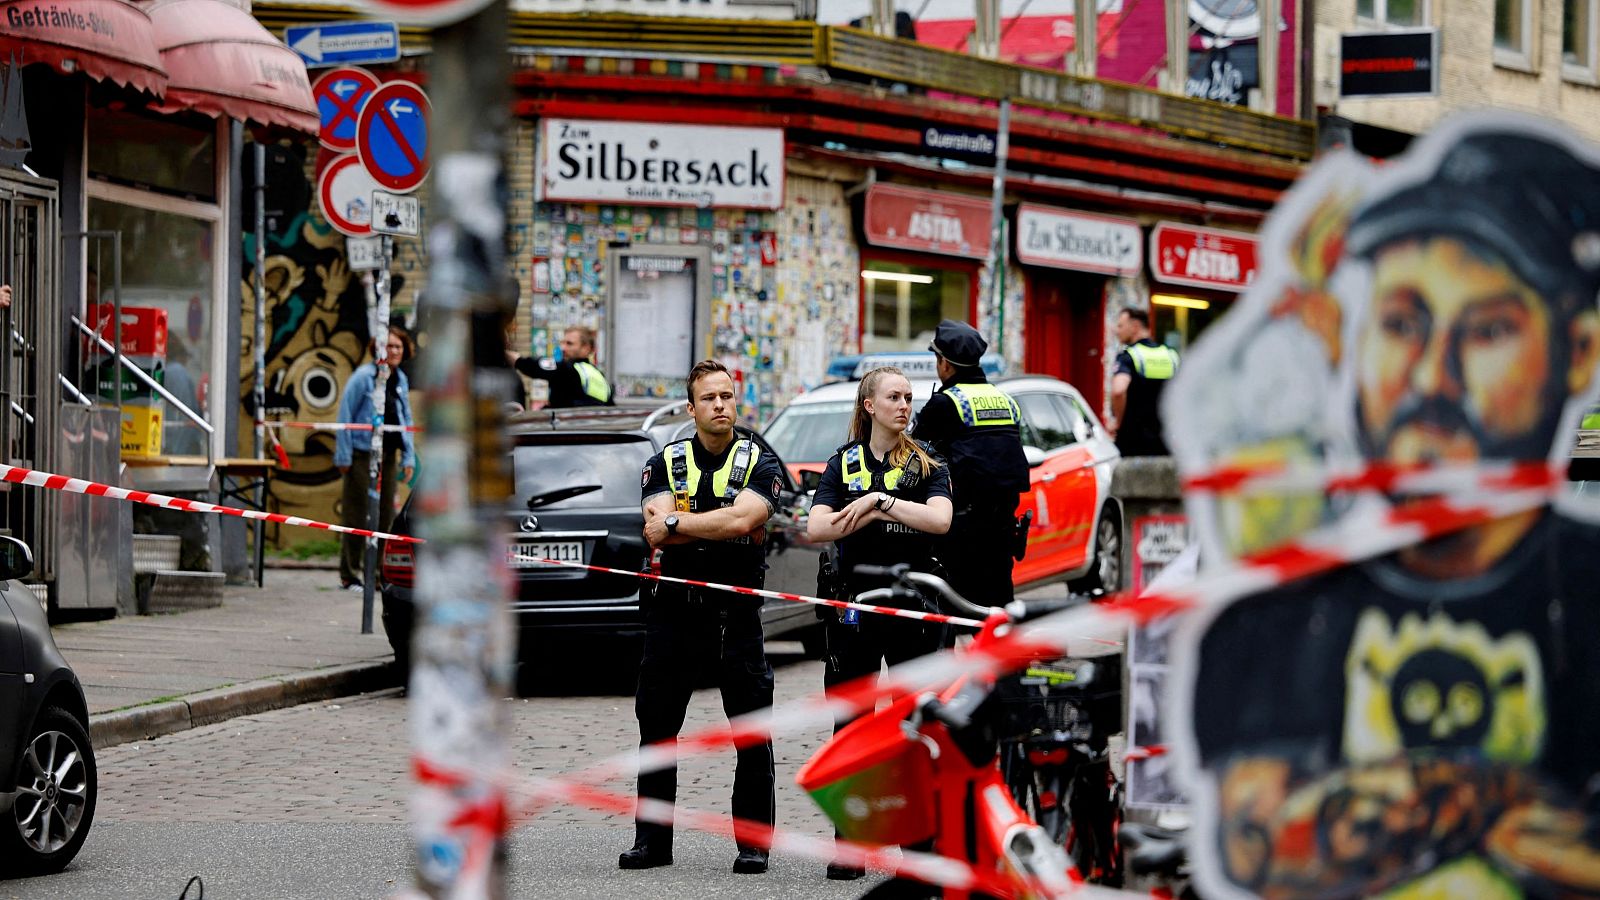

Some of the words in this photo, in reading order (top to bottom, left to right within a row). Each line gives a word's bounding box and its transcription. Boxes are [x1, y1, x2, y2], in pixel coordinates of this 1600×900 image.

[925, 127, 995, 154] Querstraße
[907, 211, 965, 244] ASTRA
[1184, 248, 1240, 281] ASTRA
[863, 360, 936, 372] FEUERWE
[972, 395, 1008, 409] POLIZEI
[543, 544, 580, 561] 1111
